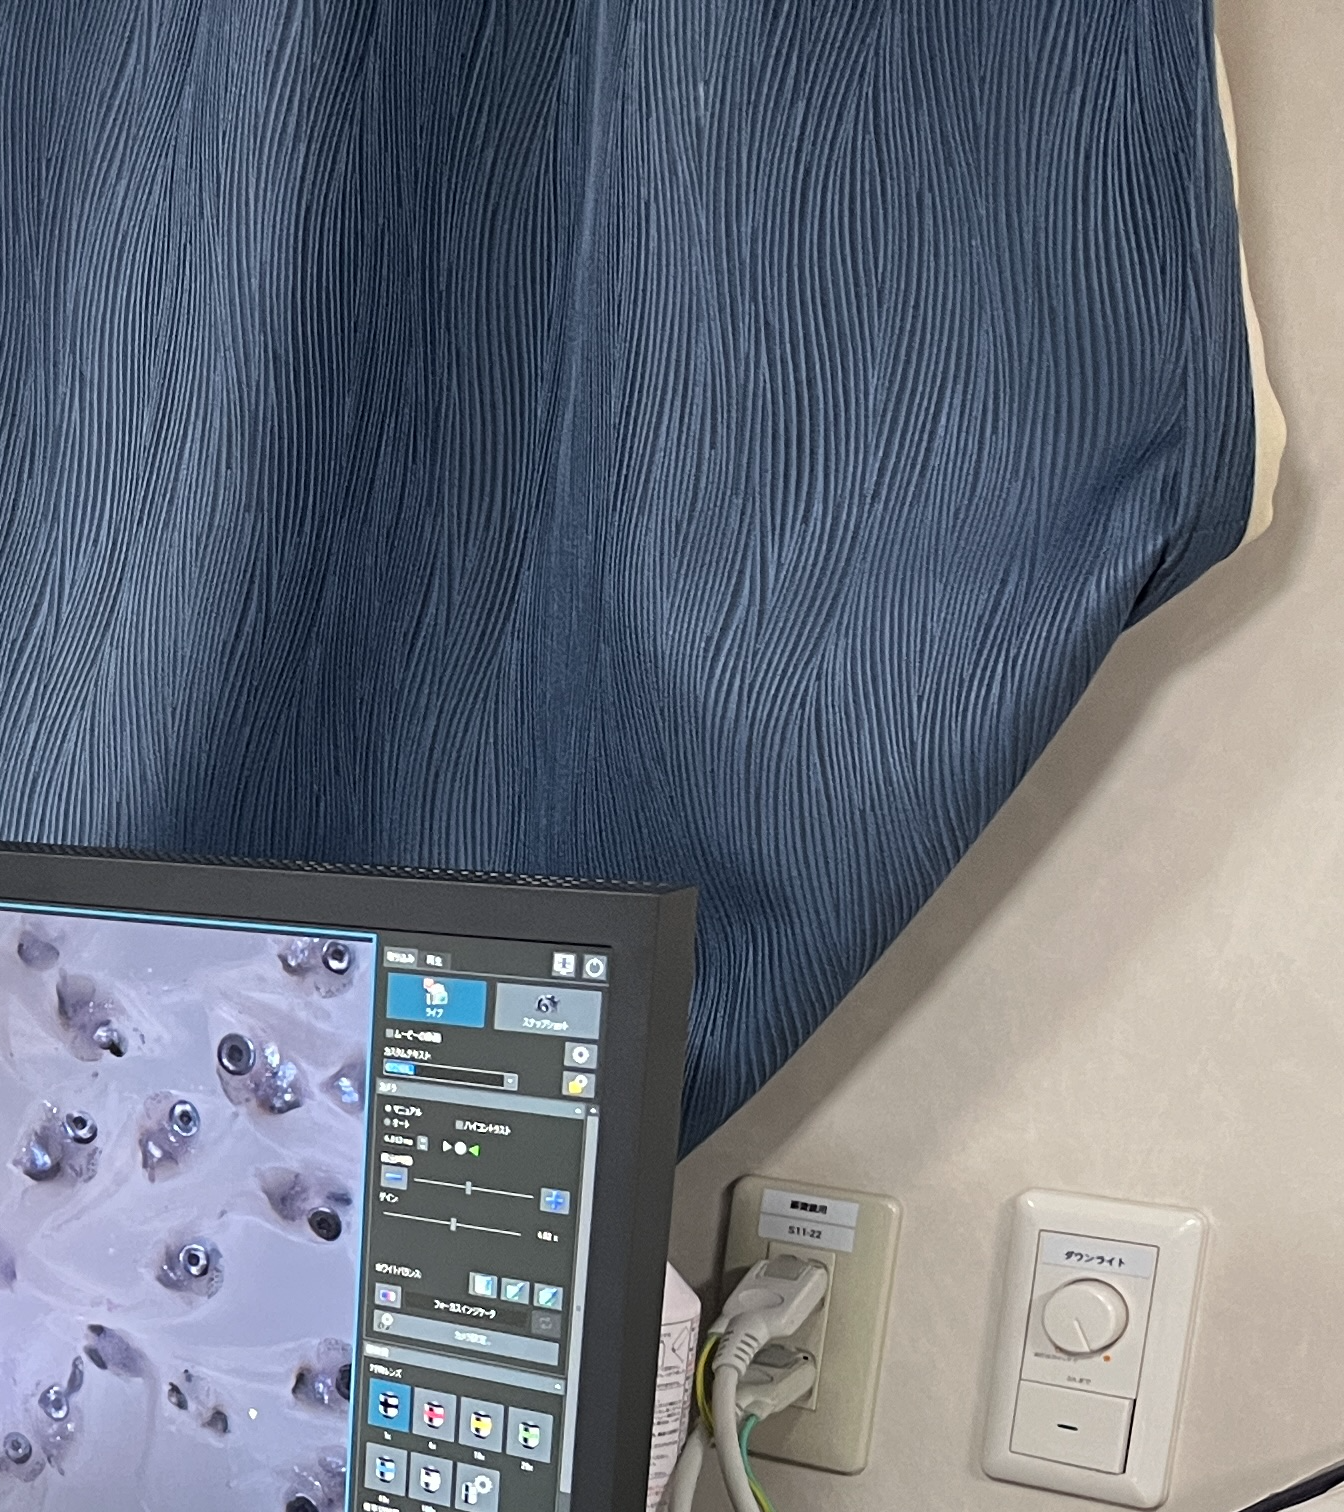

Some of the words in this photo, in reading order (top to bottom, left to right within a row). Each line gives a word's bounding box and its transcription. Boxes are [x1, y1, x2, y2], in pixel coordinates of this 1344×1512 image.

[1064, 1250, 1126, 1268] ダウンライト
